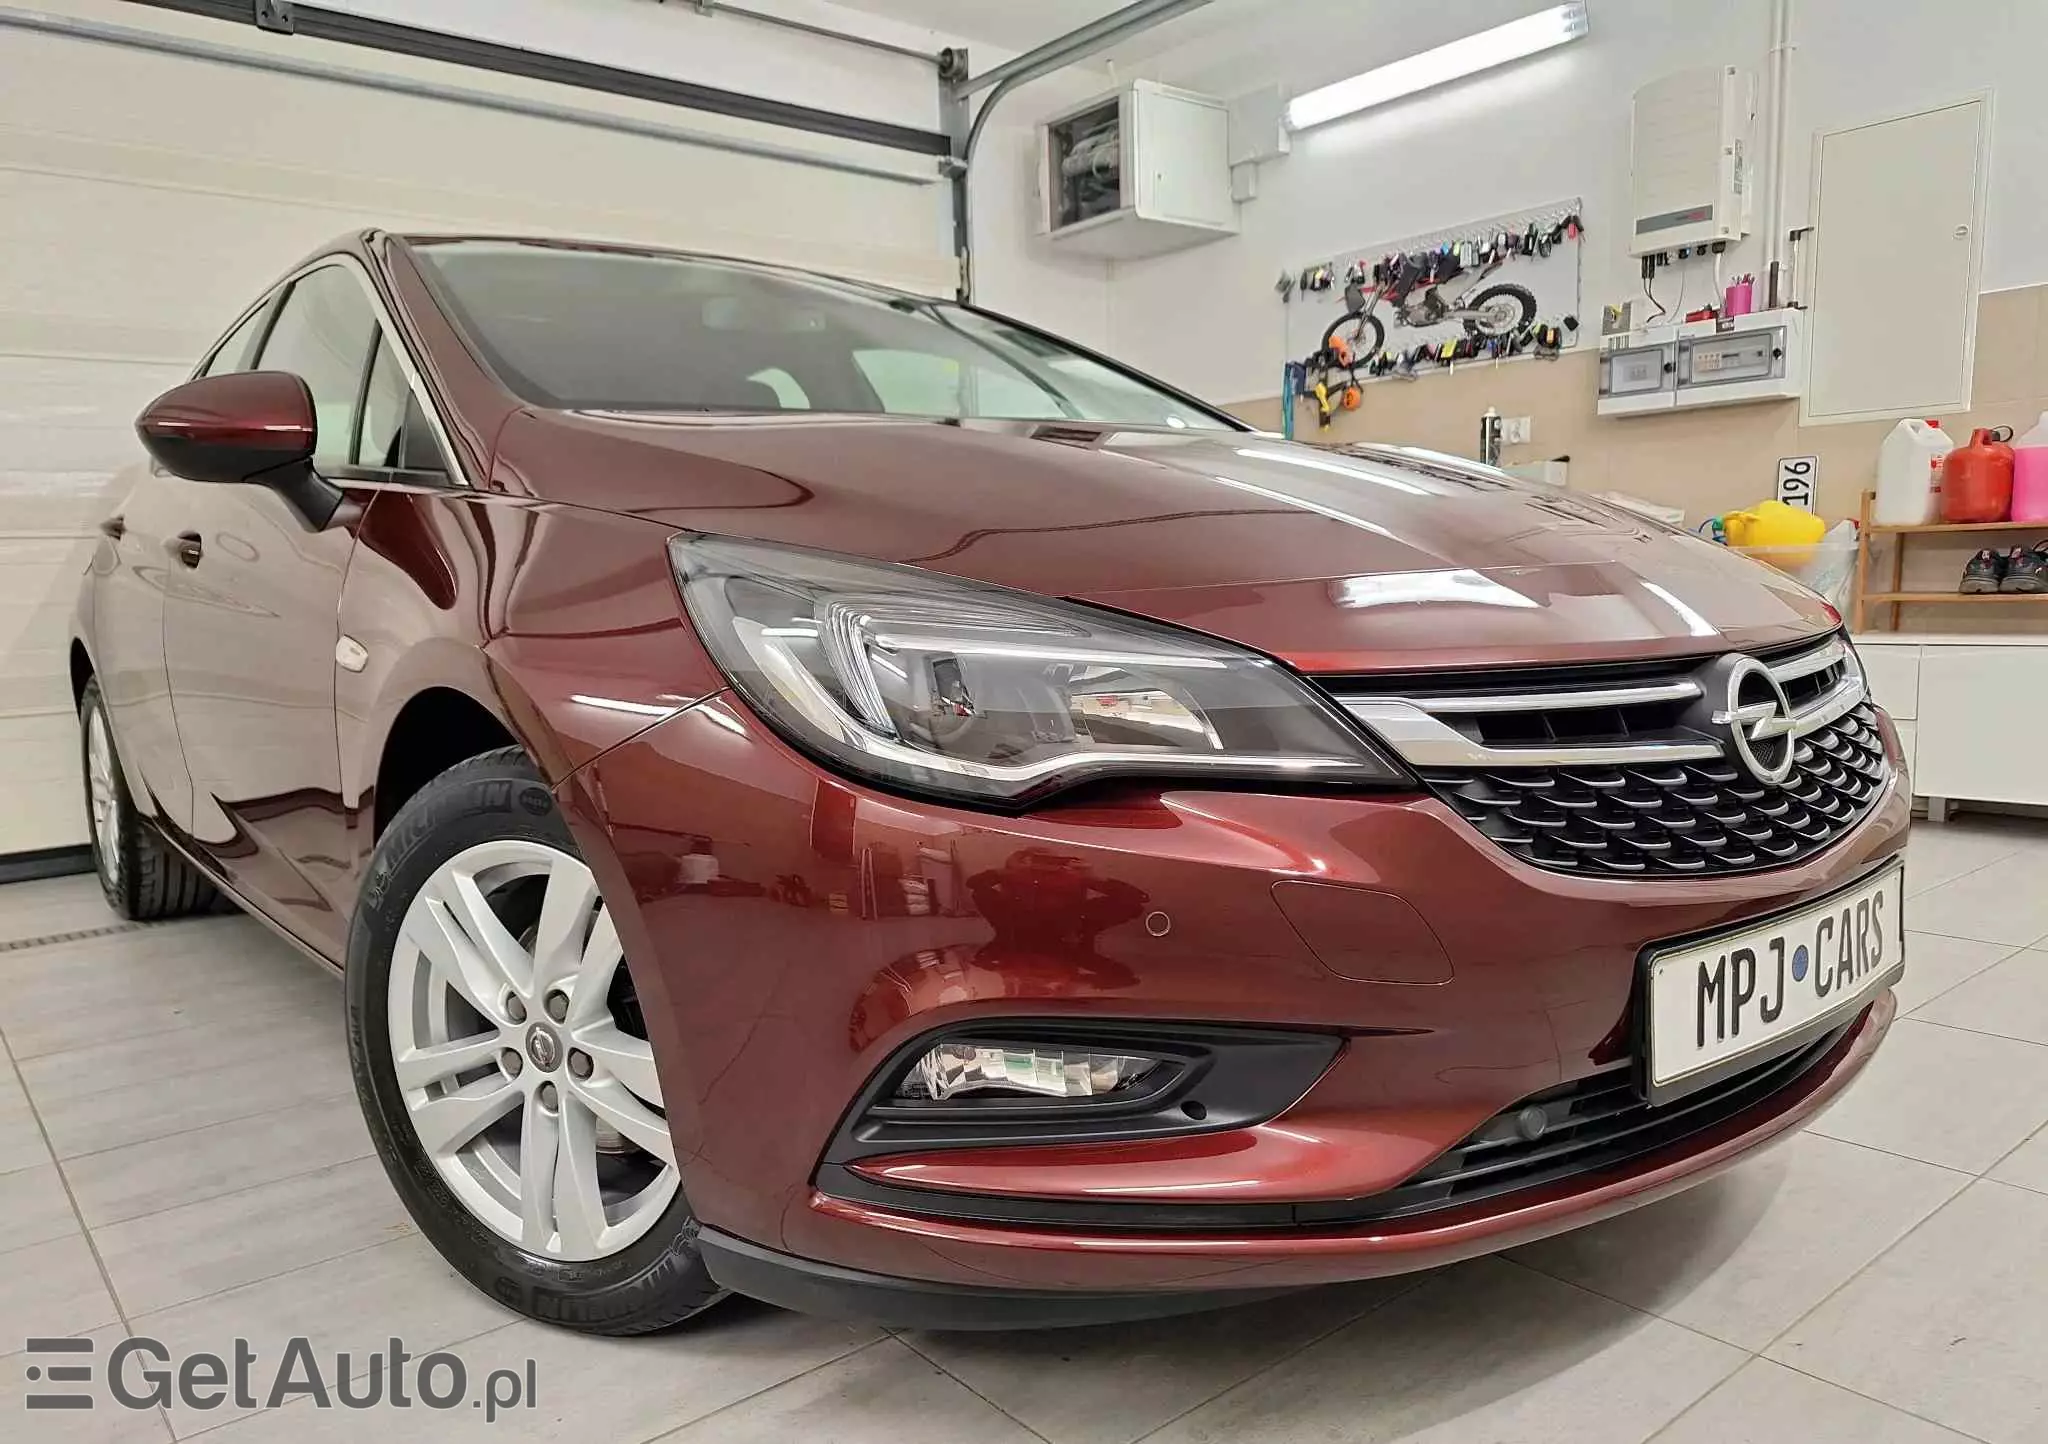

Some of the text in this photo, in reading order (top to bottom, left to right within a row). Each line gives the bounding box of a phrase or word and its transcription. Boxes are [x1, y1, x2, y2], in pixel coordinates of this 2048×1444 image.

[1782, 462, 1811, 506] 196
[1697, 891, 1884, 1050] MPJ CARS
